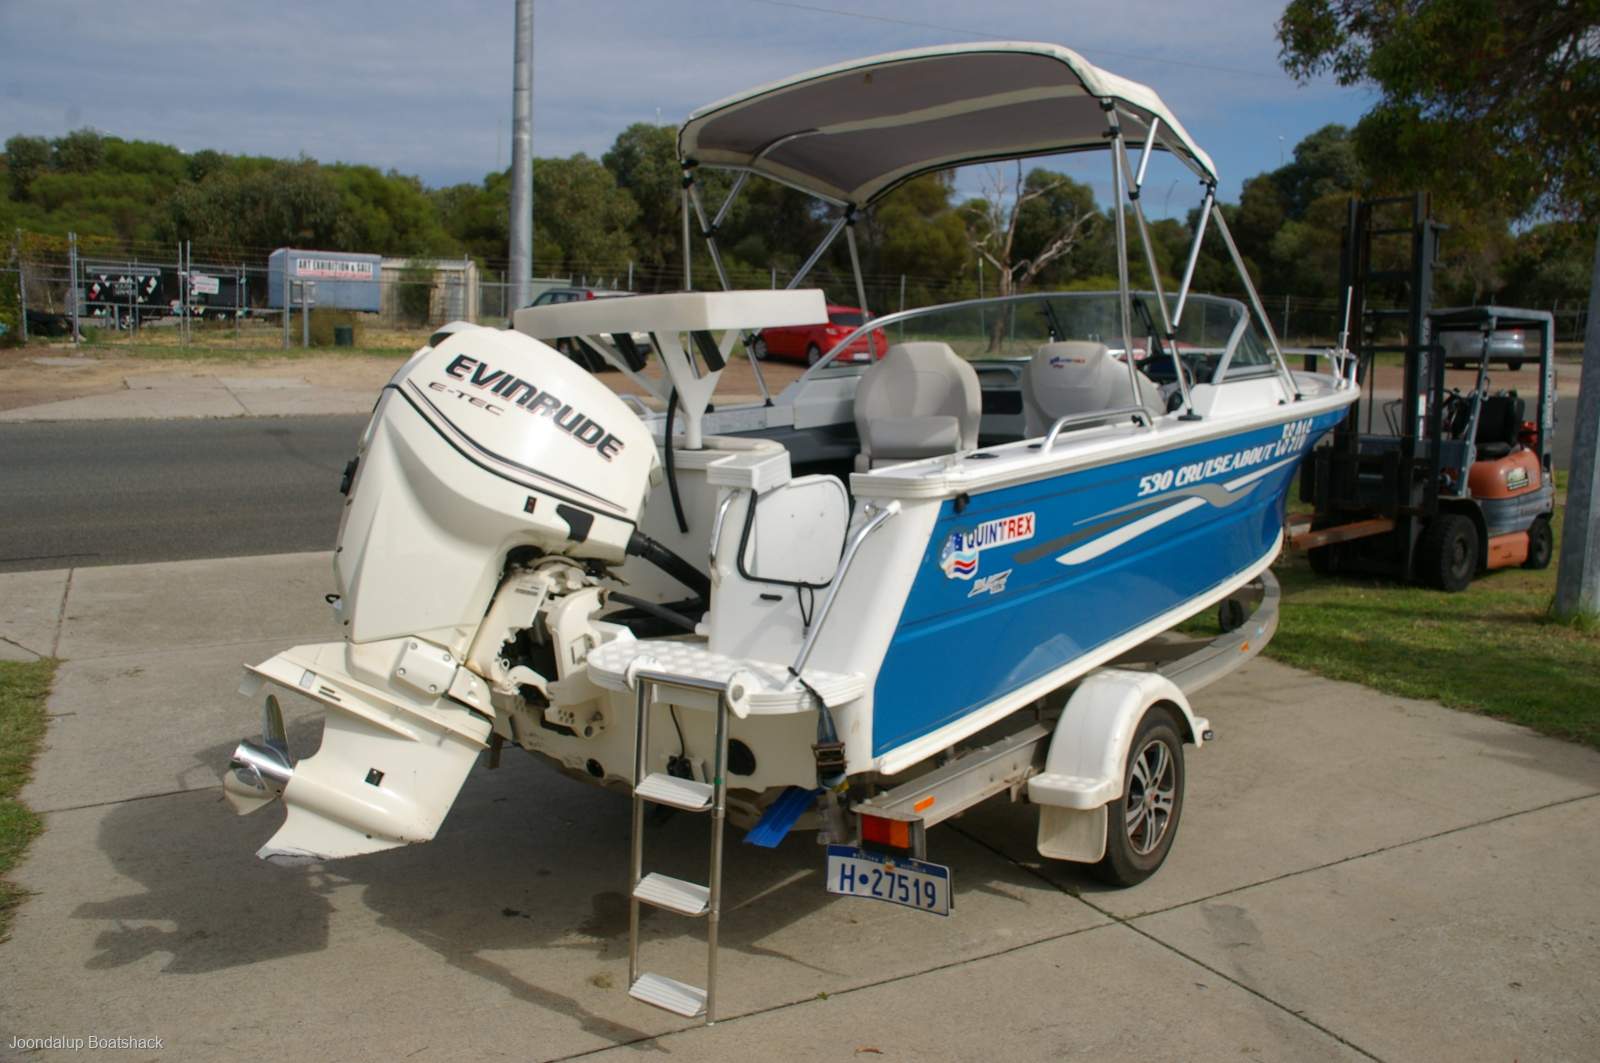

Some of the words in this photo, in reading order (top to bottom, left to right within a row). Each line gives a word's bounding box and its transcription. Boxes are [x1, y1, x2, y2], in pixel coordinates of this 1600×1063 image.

[428, 381, 505, 416] E-TEC
[445, 353, 625, 462] EVINRUDE
[1137, 470, 1174, 497] 530
[1175, 443, 1276, 487] CRUISEABOUT
[966, 514, 1033, 549] QUINTREX
